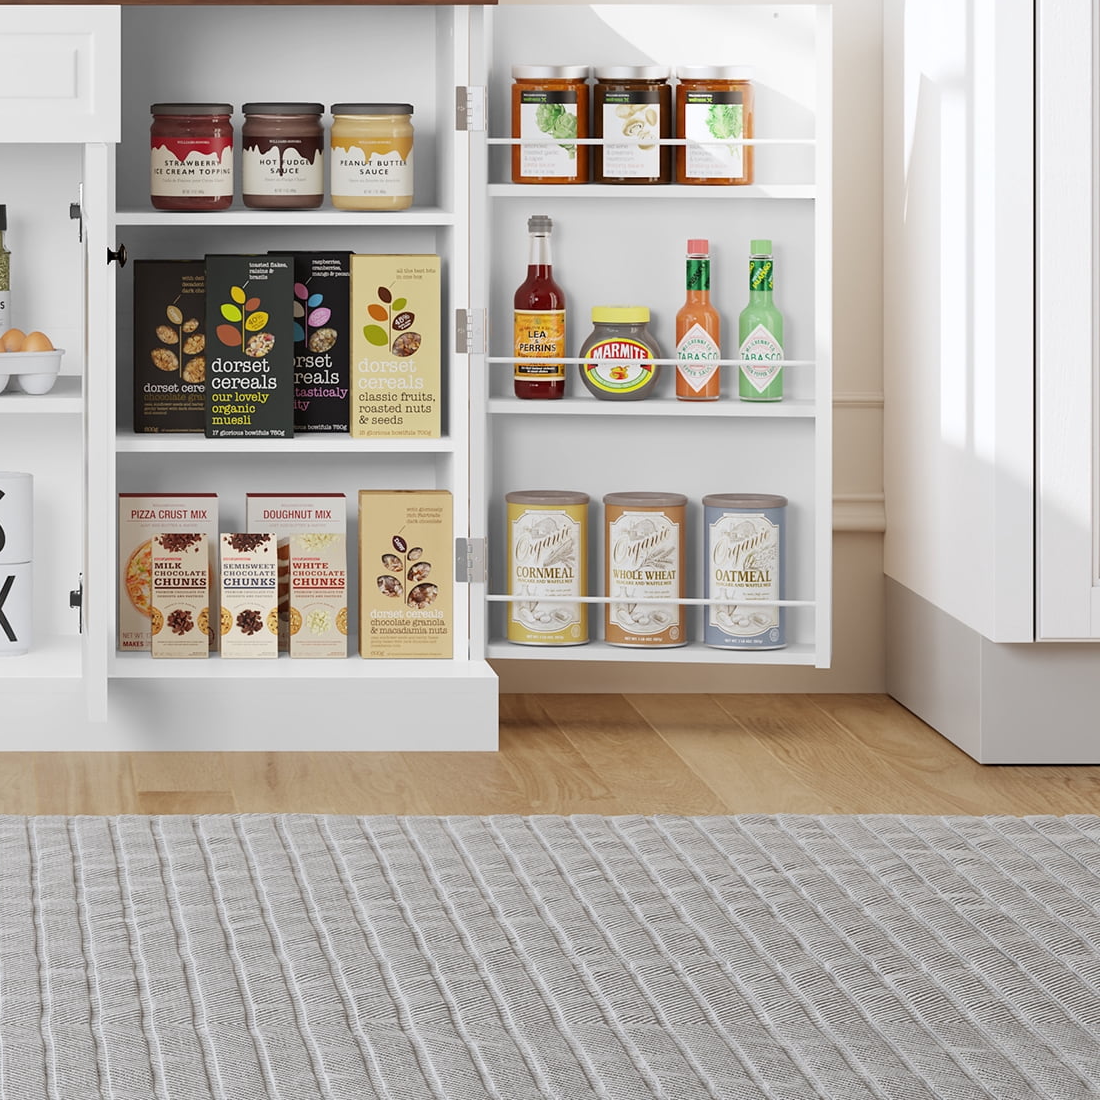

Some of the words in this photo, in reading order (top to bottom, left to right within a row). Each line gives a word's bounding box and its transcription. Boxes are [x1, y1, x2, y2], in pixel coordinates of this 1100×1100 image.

[528, 330, 546, 338] LEA
[520, 344, 556, 352] PERRINS
[593, 343, 647, 359] MARMITE
[212, 358, 270, 372] dorset
[294, 354, 332, 368] rset
[358, 358, 416, 372] dorset
[212, 374, 277, 390] cereals
[294, 370, 340, 384] reals
[358, 375, 424, 389] cereals
[144, 382, 180, 392] dorset
[181, 384, 205, 392] cere
[212, 393, 232, 402] our
[234, 392, 270, 404] lovely
[295, 387, 348, 399] tasticaly
[358, 392, 398, 402] classic
[401, 392, 436, 402] fruits,
[212, 404, 256, 415] organic
[359, 404, 402, 413] roasted
[406, 405, 432, 413] nuts
[212, 415, 252, 424] muesli
[358, 415, 368, 424] &
[372, 415, 404, 424] seeds
[131, 510, 156, 519] PIZZA
[158, 510, 188, 519] CRUST
[190, 510, 207, 519] MIX
[264, 510, 312, 519] DOUGHNUT
[315, 510, 332, 519] MIX
[516, 524, 571, 566] Organic
[613, 526, 670, 566] Organic
[713, 528, 770, 567] Organic
[154, 562, 182, 570] MILK
[293, 562, 328, 570] WHITE
[516, 566, 574, 578] CORNMEAL
[612, 569, 643, 580] WHOLE
[645, 570, 676, 580] WHEAT
[716, 568, 772, 582] OATMEAL
[154, 578, 206, 586] CHUNKS
[224, 578, 276, 586] CHUNKS
[292, 578, 345, 586] CHUNKS
[370, 610, 404, 618] dorset
[406, 609, 444, 618] cereals
[370, 618, 411, 626] chocolate
[412, 618, 445, 627] granola
